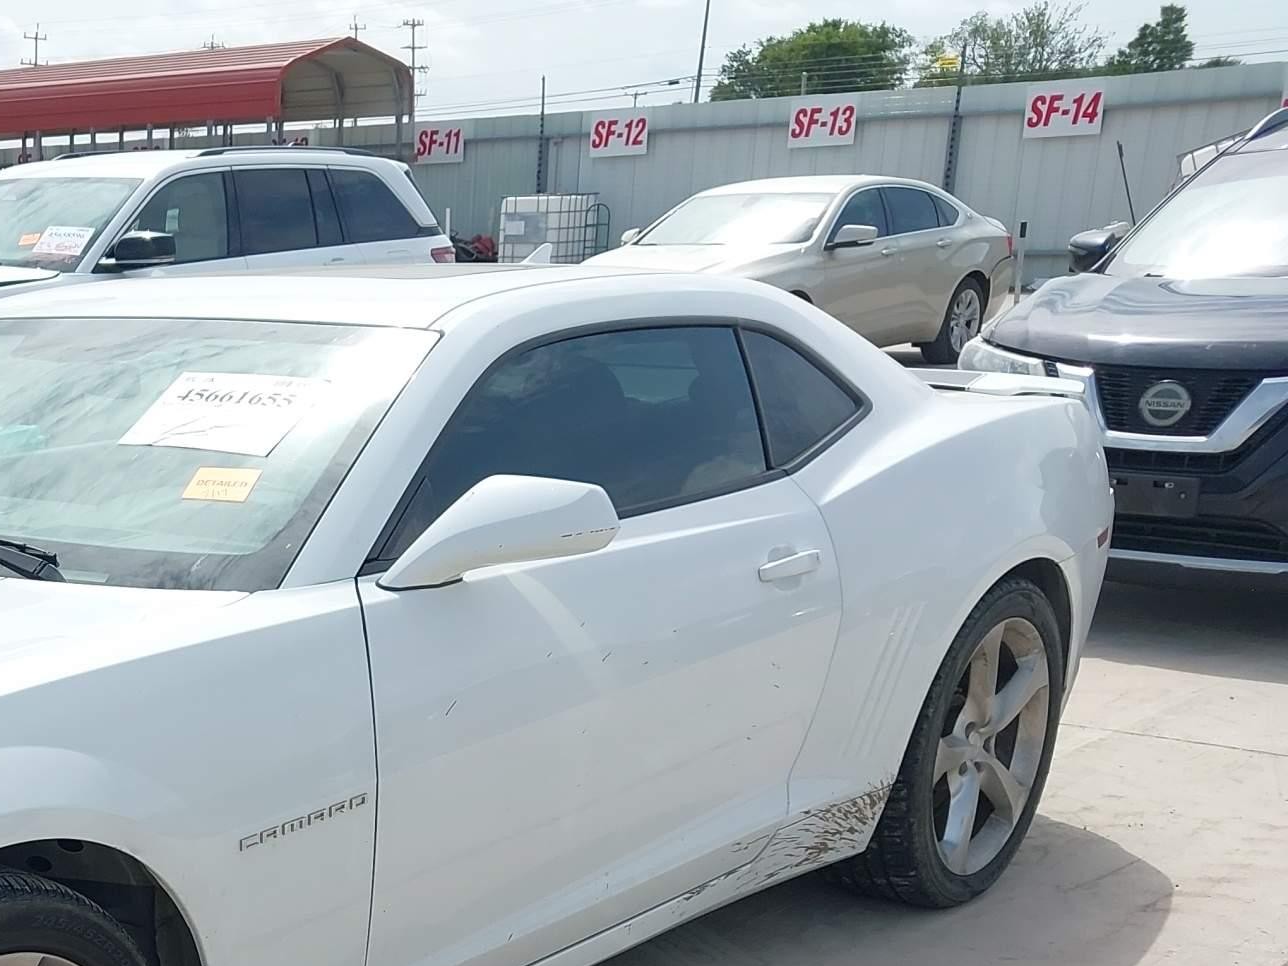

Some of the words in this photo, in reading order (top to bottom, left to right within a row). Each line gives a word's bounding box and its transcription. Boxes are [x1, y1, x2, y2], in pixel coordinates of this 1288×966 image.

[790, 105, 855, 139] SF-13
[1027, 91, 1103, 128] SF-14
[416, 128, 461, 157] SF-11
[591, 117, 647, 149] SF-12
[176, 387, 297, 408] 45661655
[1145, 399, 1185, 409] NISSAN
[239, 792, 368, 851] CAMARO
